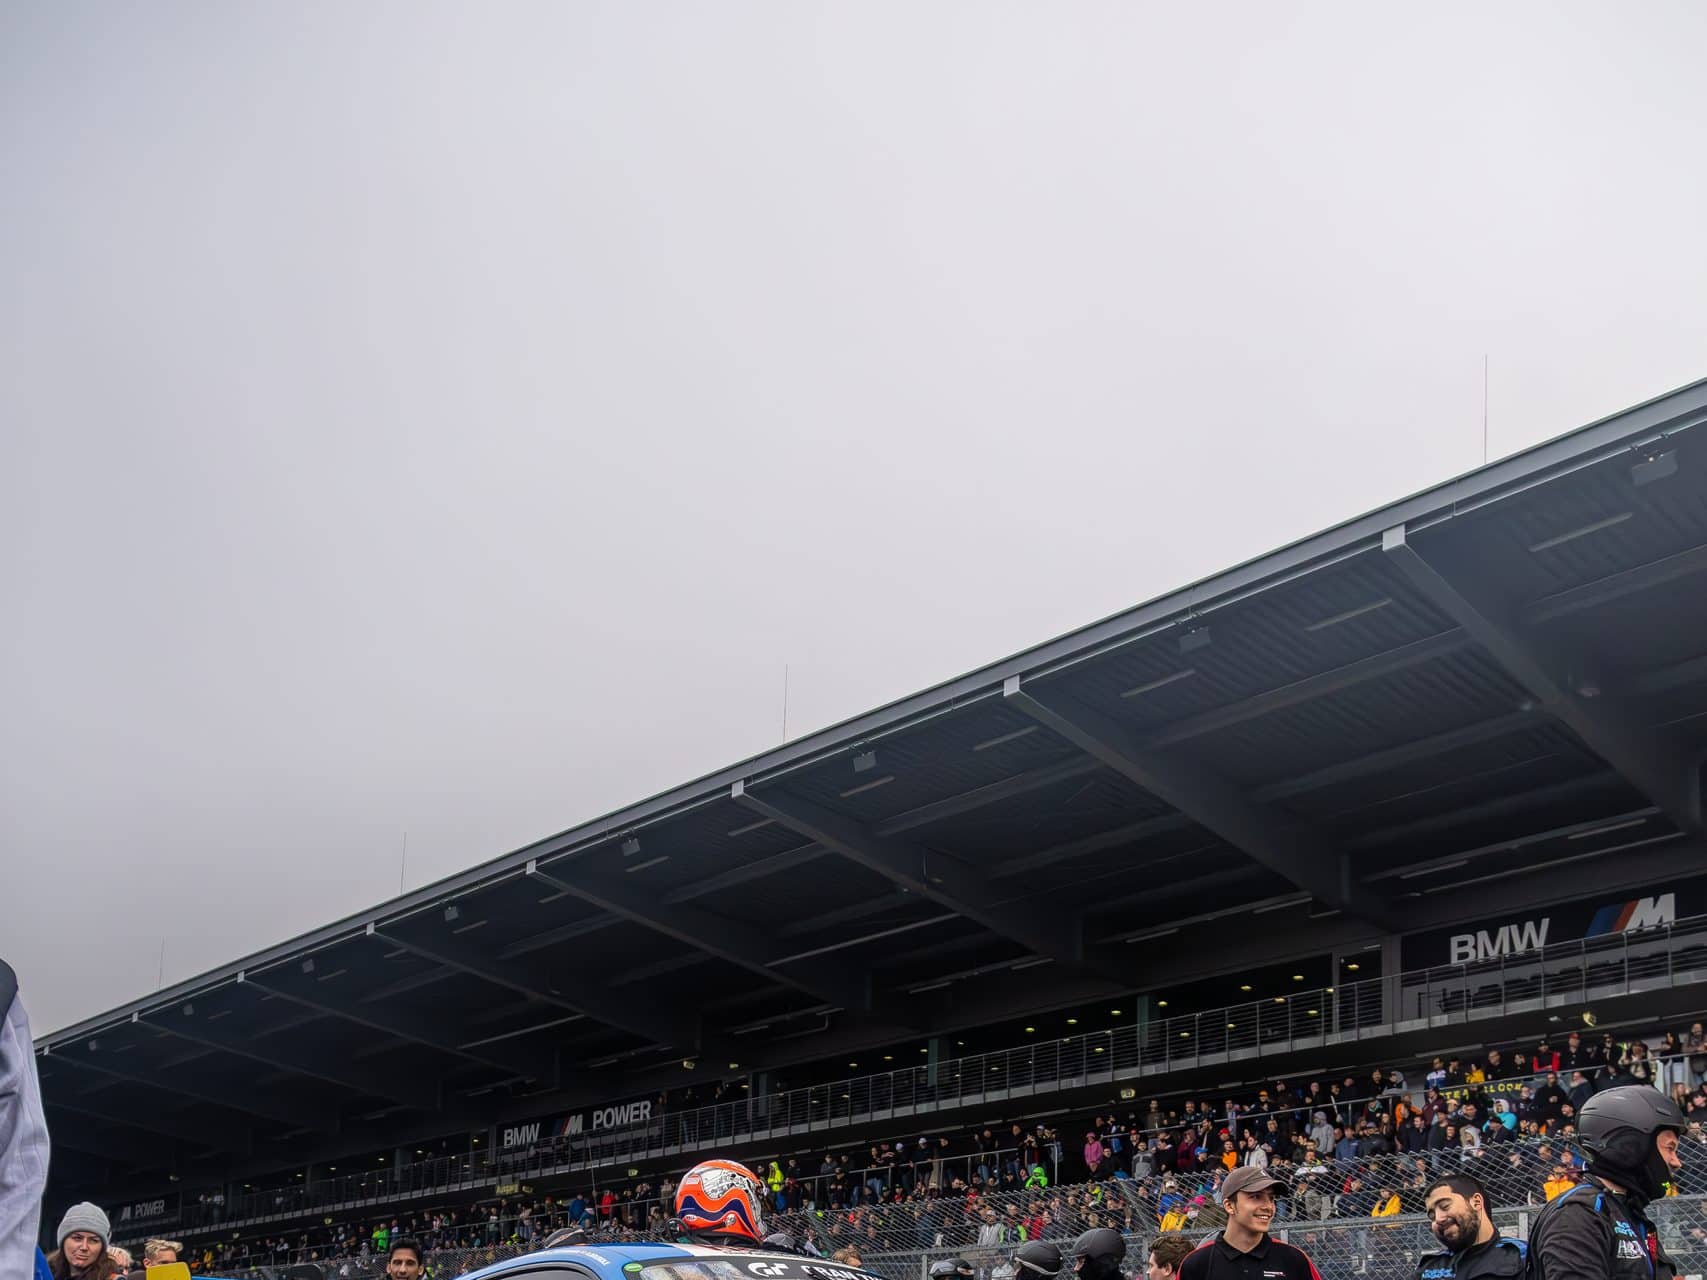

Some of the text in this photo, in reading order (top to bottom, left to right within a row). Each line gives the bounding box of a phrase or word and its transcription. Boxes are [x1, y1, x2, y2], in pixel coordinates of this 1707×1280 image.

[1449, 893, 1675, 964] BMW M
[503, 1122, 540, 1149] BMW
[592, 1101, 652, 1130] POWER
[135, 1200, 165, 1219] POWER
